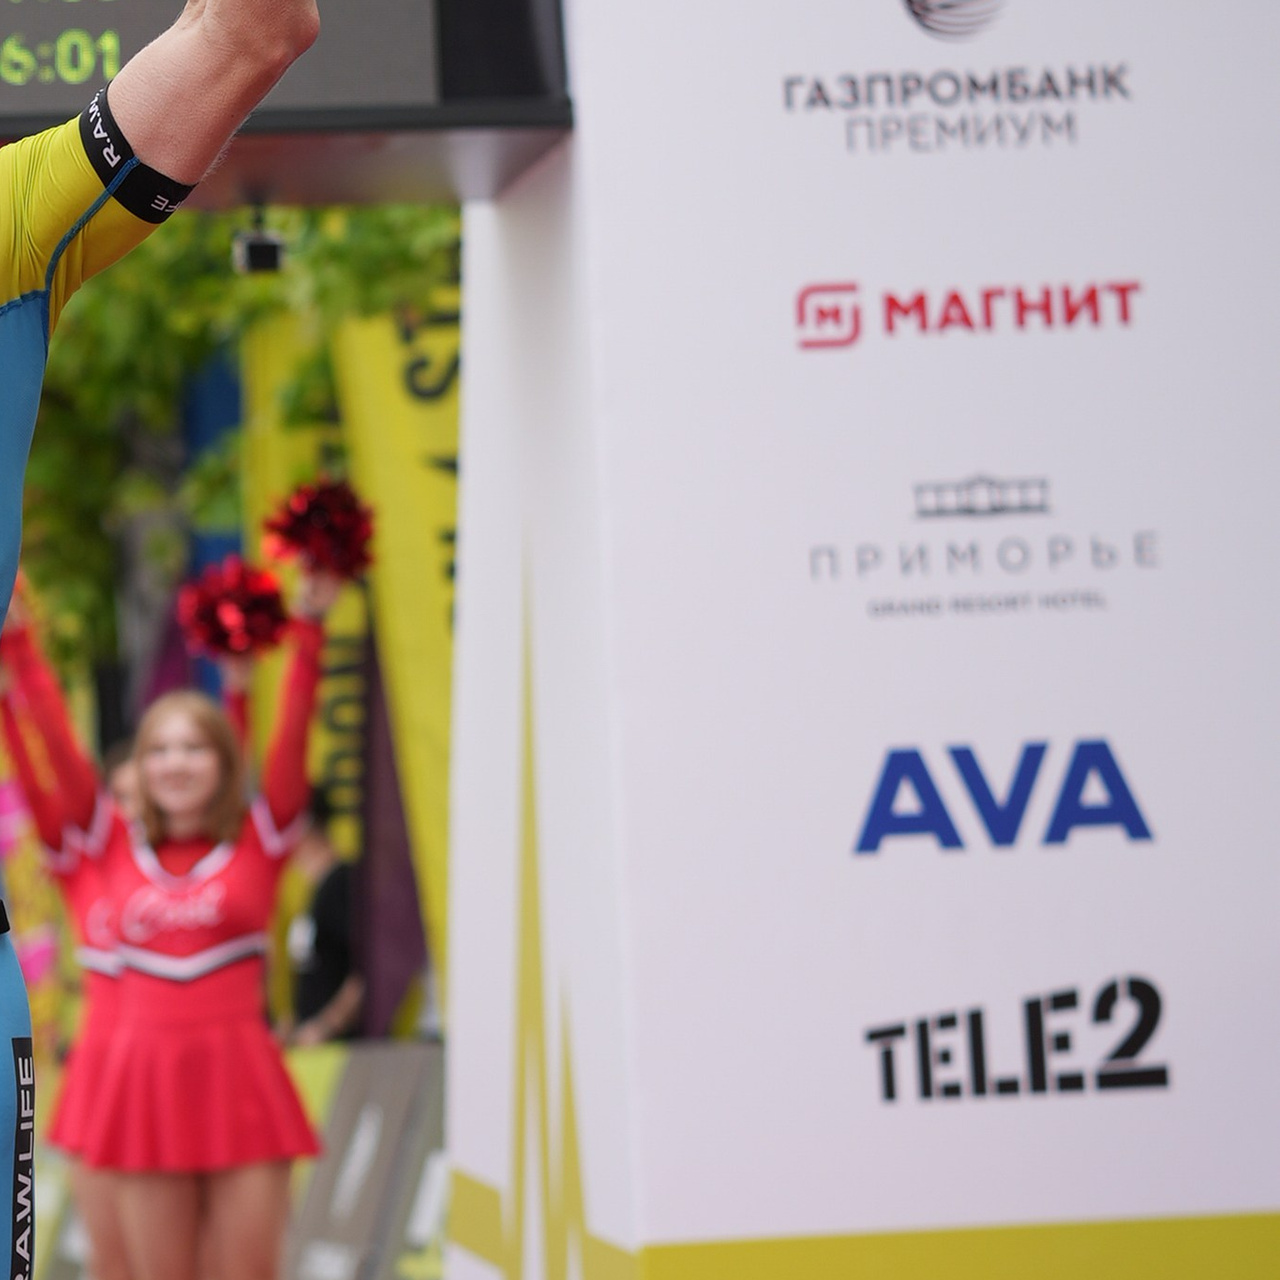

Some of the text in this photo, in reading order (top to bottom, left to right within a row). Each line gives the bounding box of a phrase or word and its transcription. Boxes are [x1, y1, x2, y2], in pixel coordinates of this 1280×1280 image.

[783, 63, 1132, 111] ГАЗПРОМБАНК
[844, 112, 1078, 152] ПРЕМИУМ
[883, 281, 1140, 334] МАГНИТ
[809, 531, 1161, 579] ПРИМОРЬЕ
[853, 738, 1154, 854] AVA
[865, 976, 1170, 1103] TELE2
